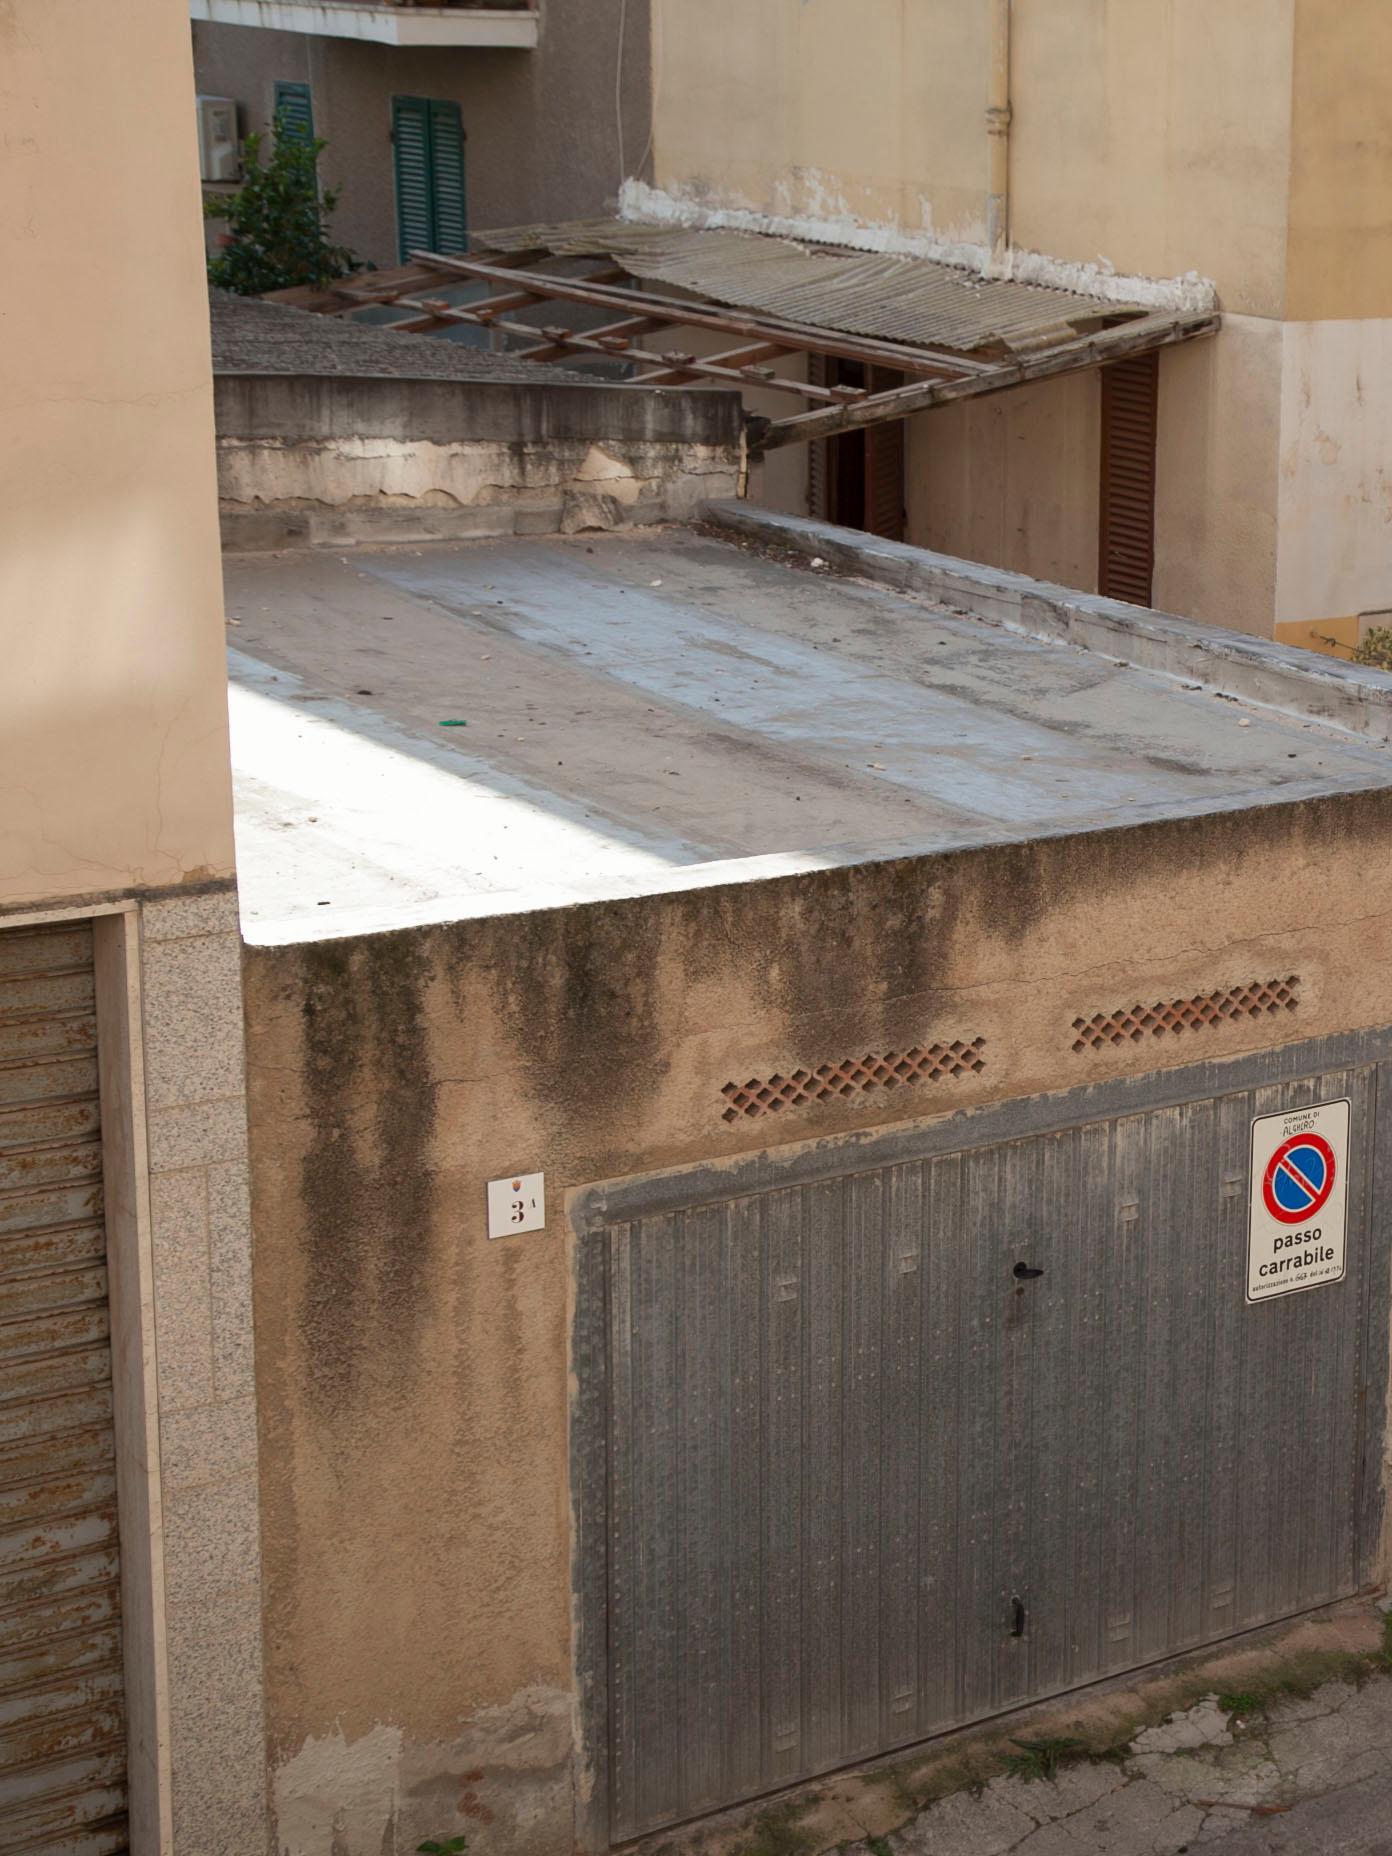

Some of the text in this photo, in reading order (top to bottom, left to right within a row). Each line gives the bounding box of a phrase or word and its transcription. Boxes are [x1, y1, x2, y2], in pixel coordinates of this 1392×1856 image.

[1282, 1120, 1315, 1137] ALGHERO
[1283, 1111, 1320, 1125] COMUNE DI
[1273, 1228, 1322, 1254] passo
[1258, 1246, 1335, 1277] carrabile
